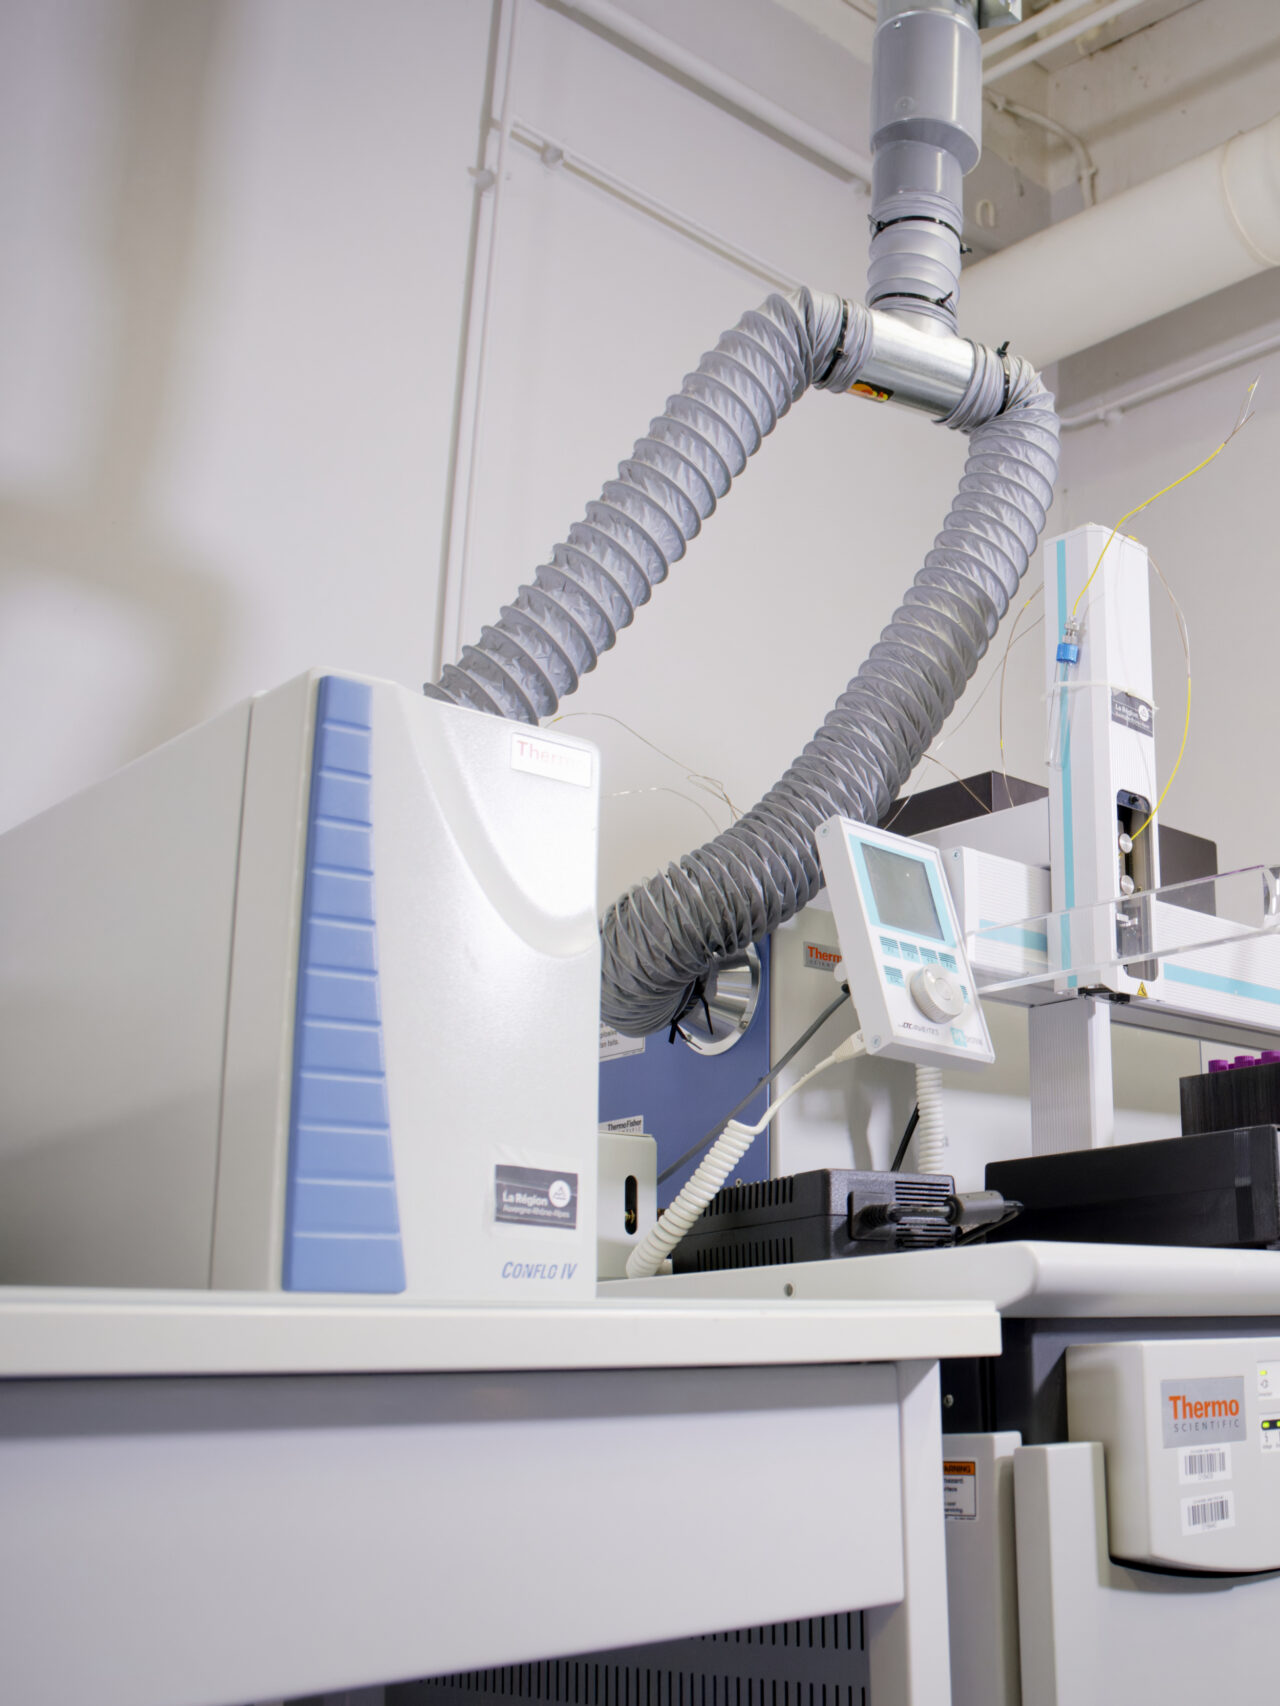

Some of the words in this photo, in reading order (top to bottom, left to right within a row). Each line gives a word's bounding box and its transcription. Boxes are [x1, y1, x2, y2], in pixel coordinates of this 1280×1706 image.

[502, 1190, 514, 1203] La
[560, 1263, 578, 1280] IV
[1169, 1395, 1240, 1420] Thermo
[1174, 1419, 1240, 1433] SCIENTIFIC
[944, 1465, 971, 1473] ARNING
